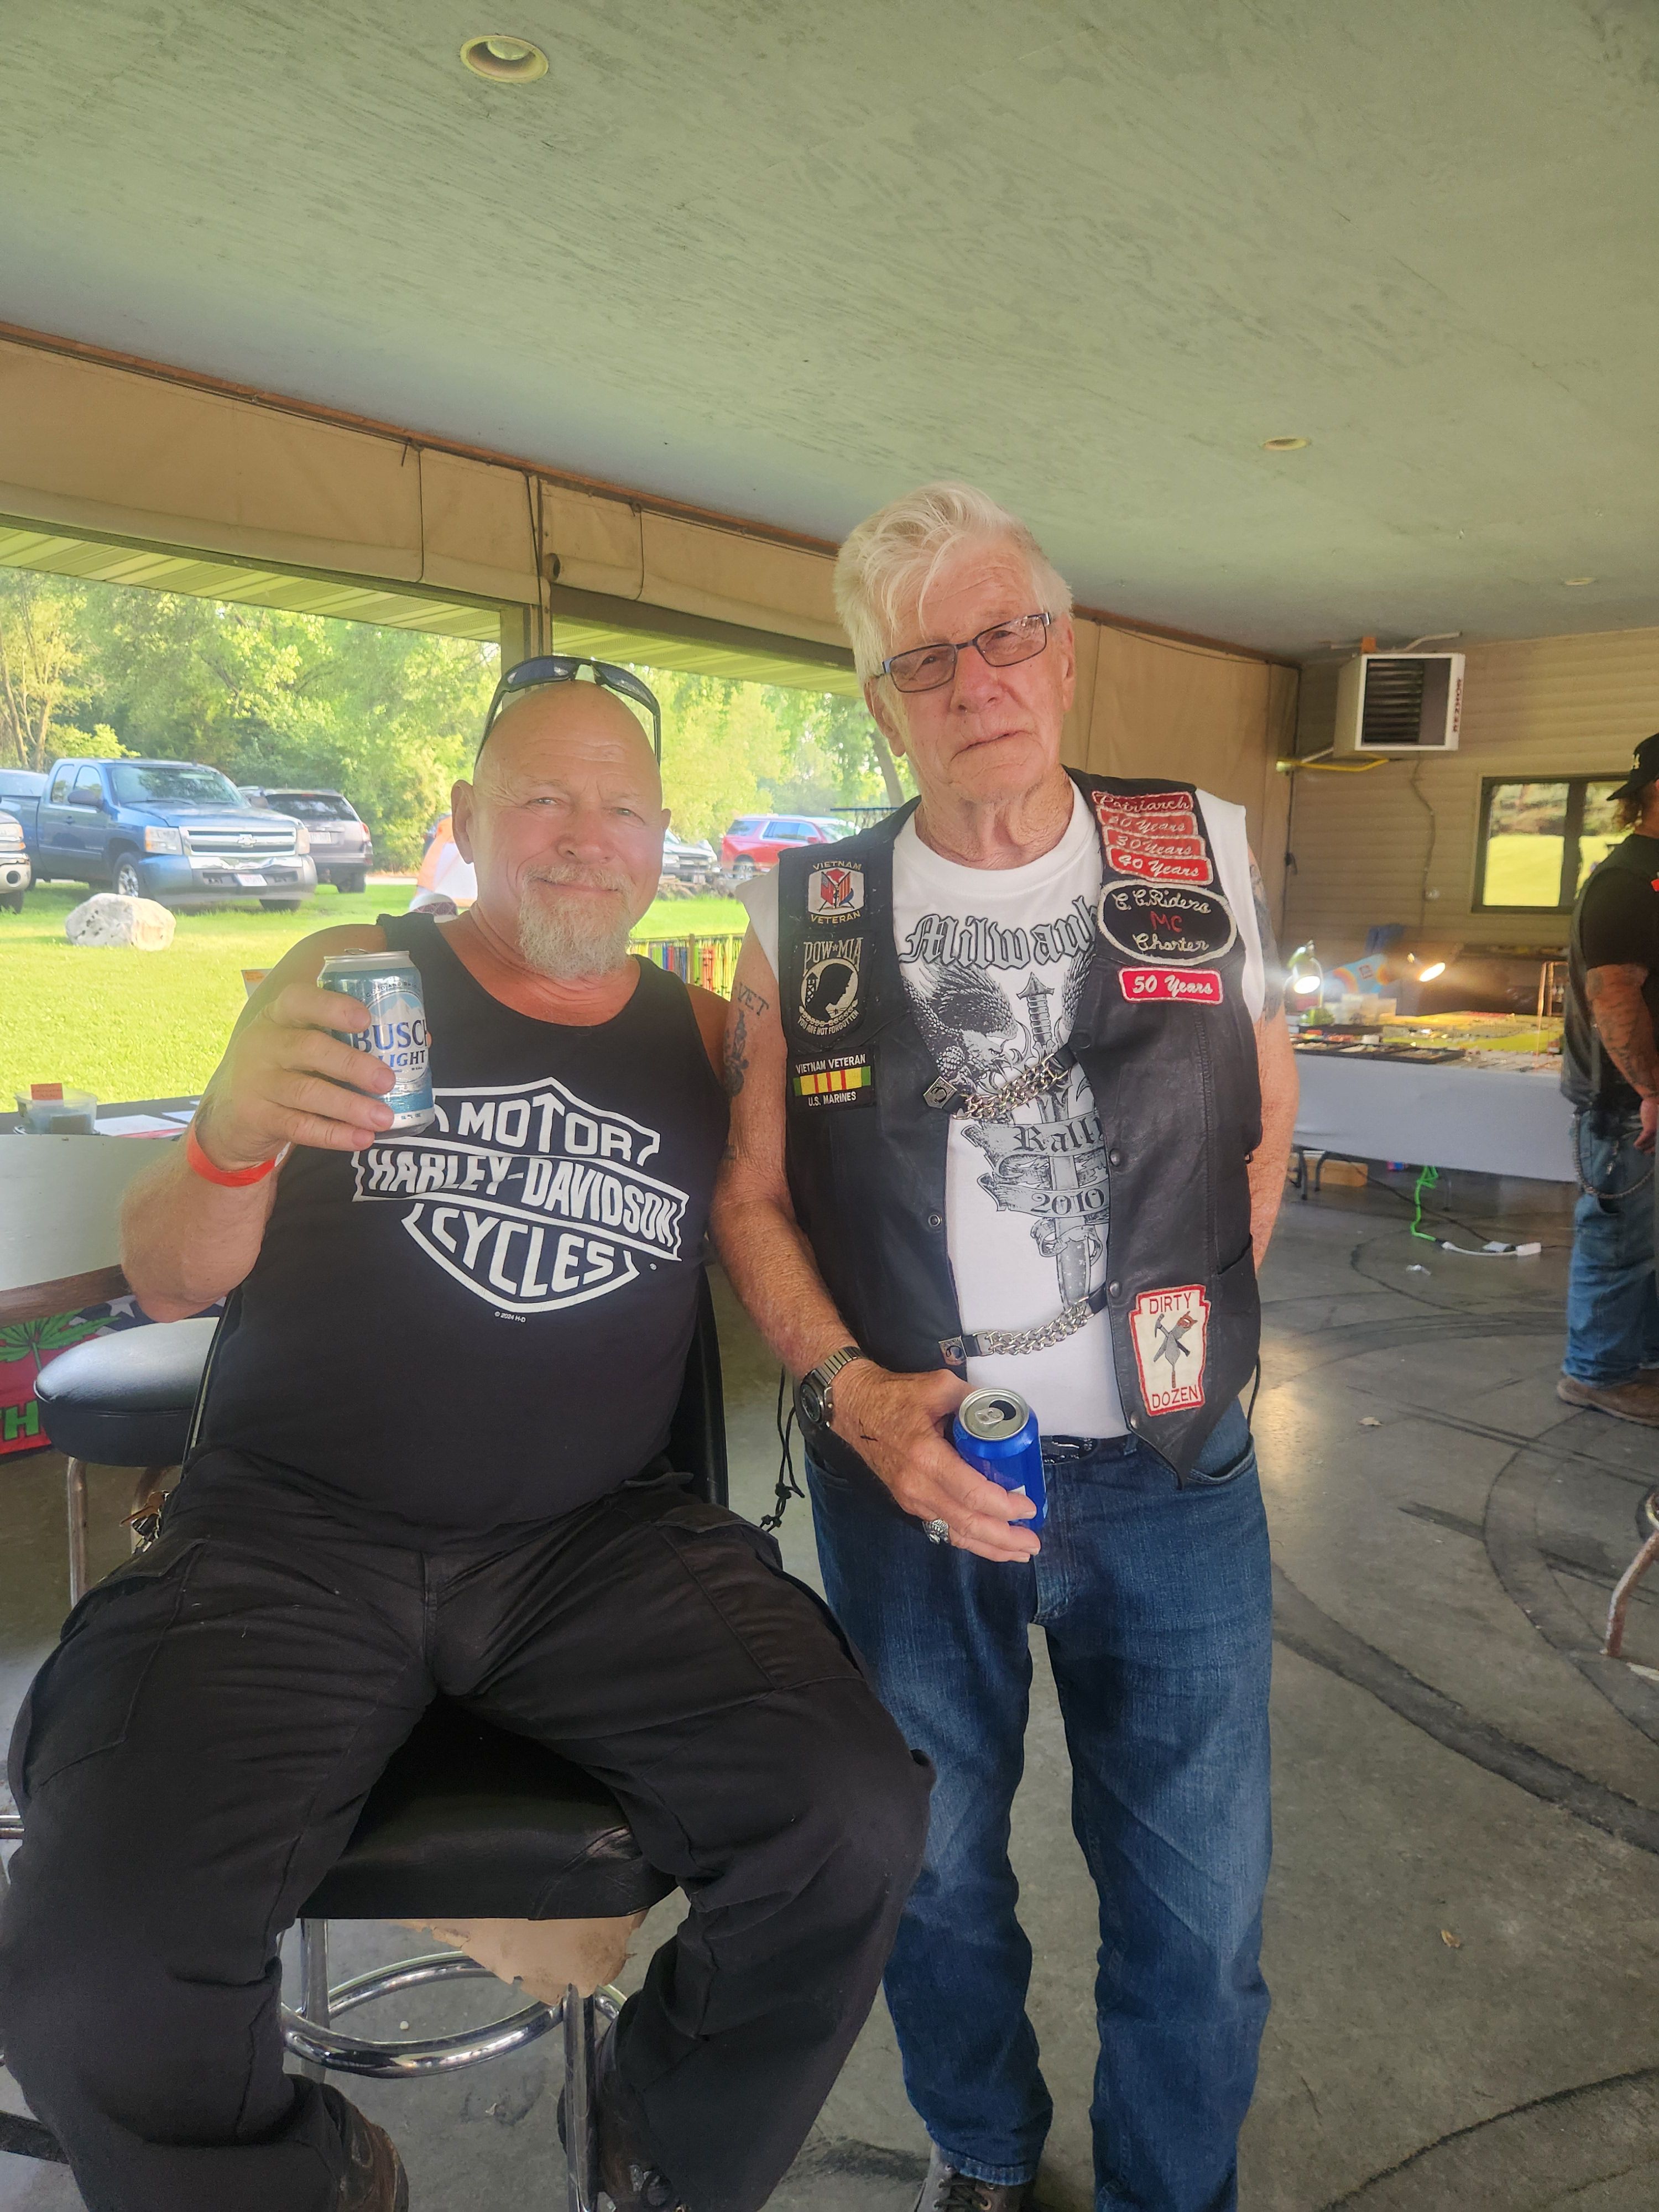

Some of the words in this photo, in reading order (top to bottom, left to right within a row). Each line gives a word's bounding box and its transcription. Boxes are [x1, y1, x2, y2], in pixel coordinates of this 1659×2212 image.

[1100, 795, 1188, 812] Patriarch
[1136, 820, 1186, 834] Years
[1117, 835, 1141, 849] 30
[1142, 840, 1193, 855] Years
[813, 860, 862, 871] VIETNAM
[1118, 854, 1143, 869] 40
[1148, 860, 1199, 877] Years
[811, 910, 861, 924] VETERAN
[1150, 911, 1182, 932] MC
[1133, 933, 1209, 952] Charter
[1133, 974, 1157, 994] 50
[1164, 974, 1213, 997] Years
[737, 982, 769, 1016] VET
[798, 1016, 807, 1029] YOU
[806, 1025, 817, 1034] ARE
[816, 1027, 828, 1035] NOT
[829, 1009, 859, 1035] FORGOTTEN
[378, 1050, 425, 1067] IGHT
[796, 1060, 826, 1074] VIETNAM
[828, 1053, 865, 1069] VETERAN
[808, 1096, 821, 1107] U.S.
[823, 1091, 857, 1104] MARINES
[457, 1092, 632, 1161] MOTOR
[367, 1149, 677, 1247] HARLEY-DAVIDSON
[1030, 1188, 1104, 1215] 2010
[431, 1206, 615, 1297] CYCLES
[1150, 1292, 1193, 1314] DIRTY
[1152, 1385, 1198, 1408] DOZEN
[0, 1400, 39, 1441] H
